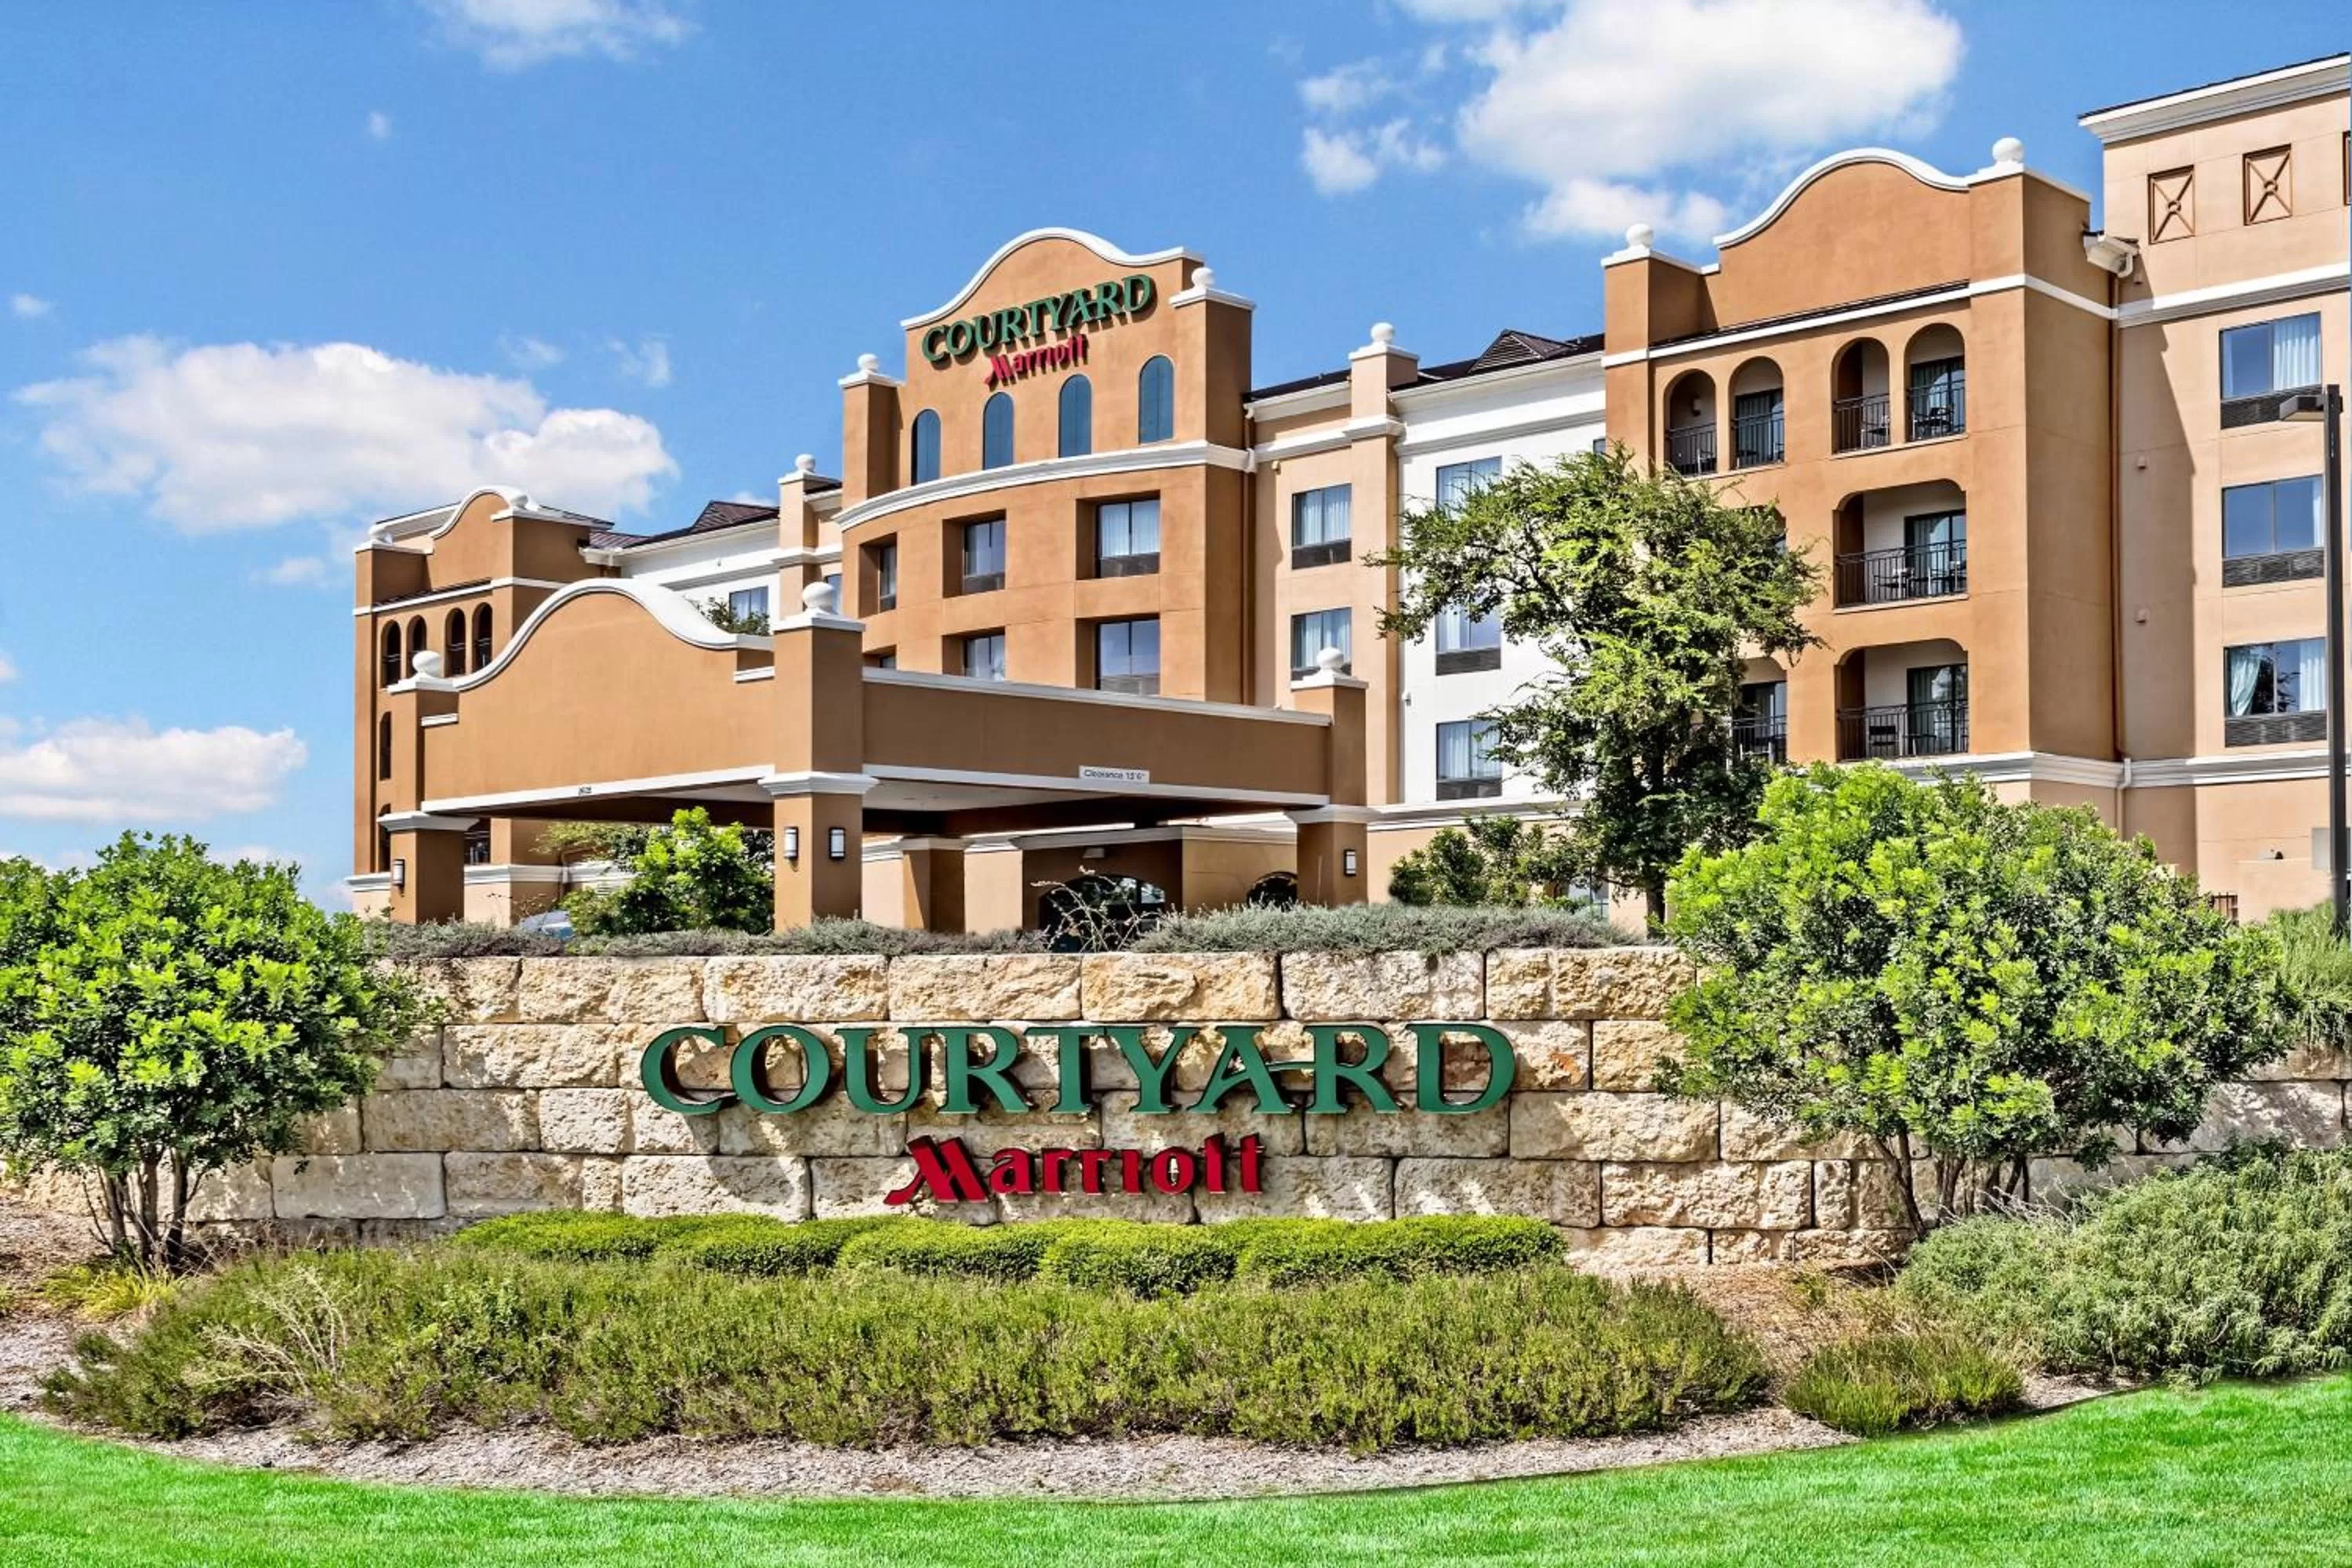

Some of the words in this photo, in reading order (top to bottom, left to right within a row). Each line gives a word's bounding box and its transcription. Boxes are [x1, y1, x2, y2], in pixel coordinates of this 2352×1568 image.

[921, 274, 1155, 363] COURTYARD
[984, 333, 1087, 387] Marriott
[641, 1022, 1516, 1114] COURTYARD
[883, 1131, 1265, 1206] Marriott
